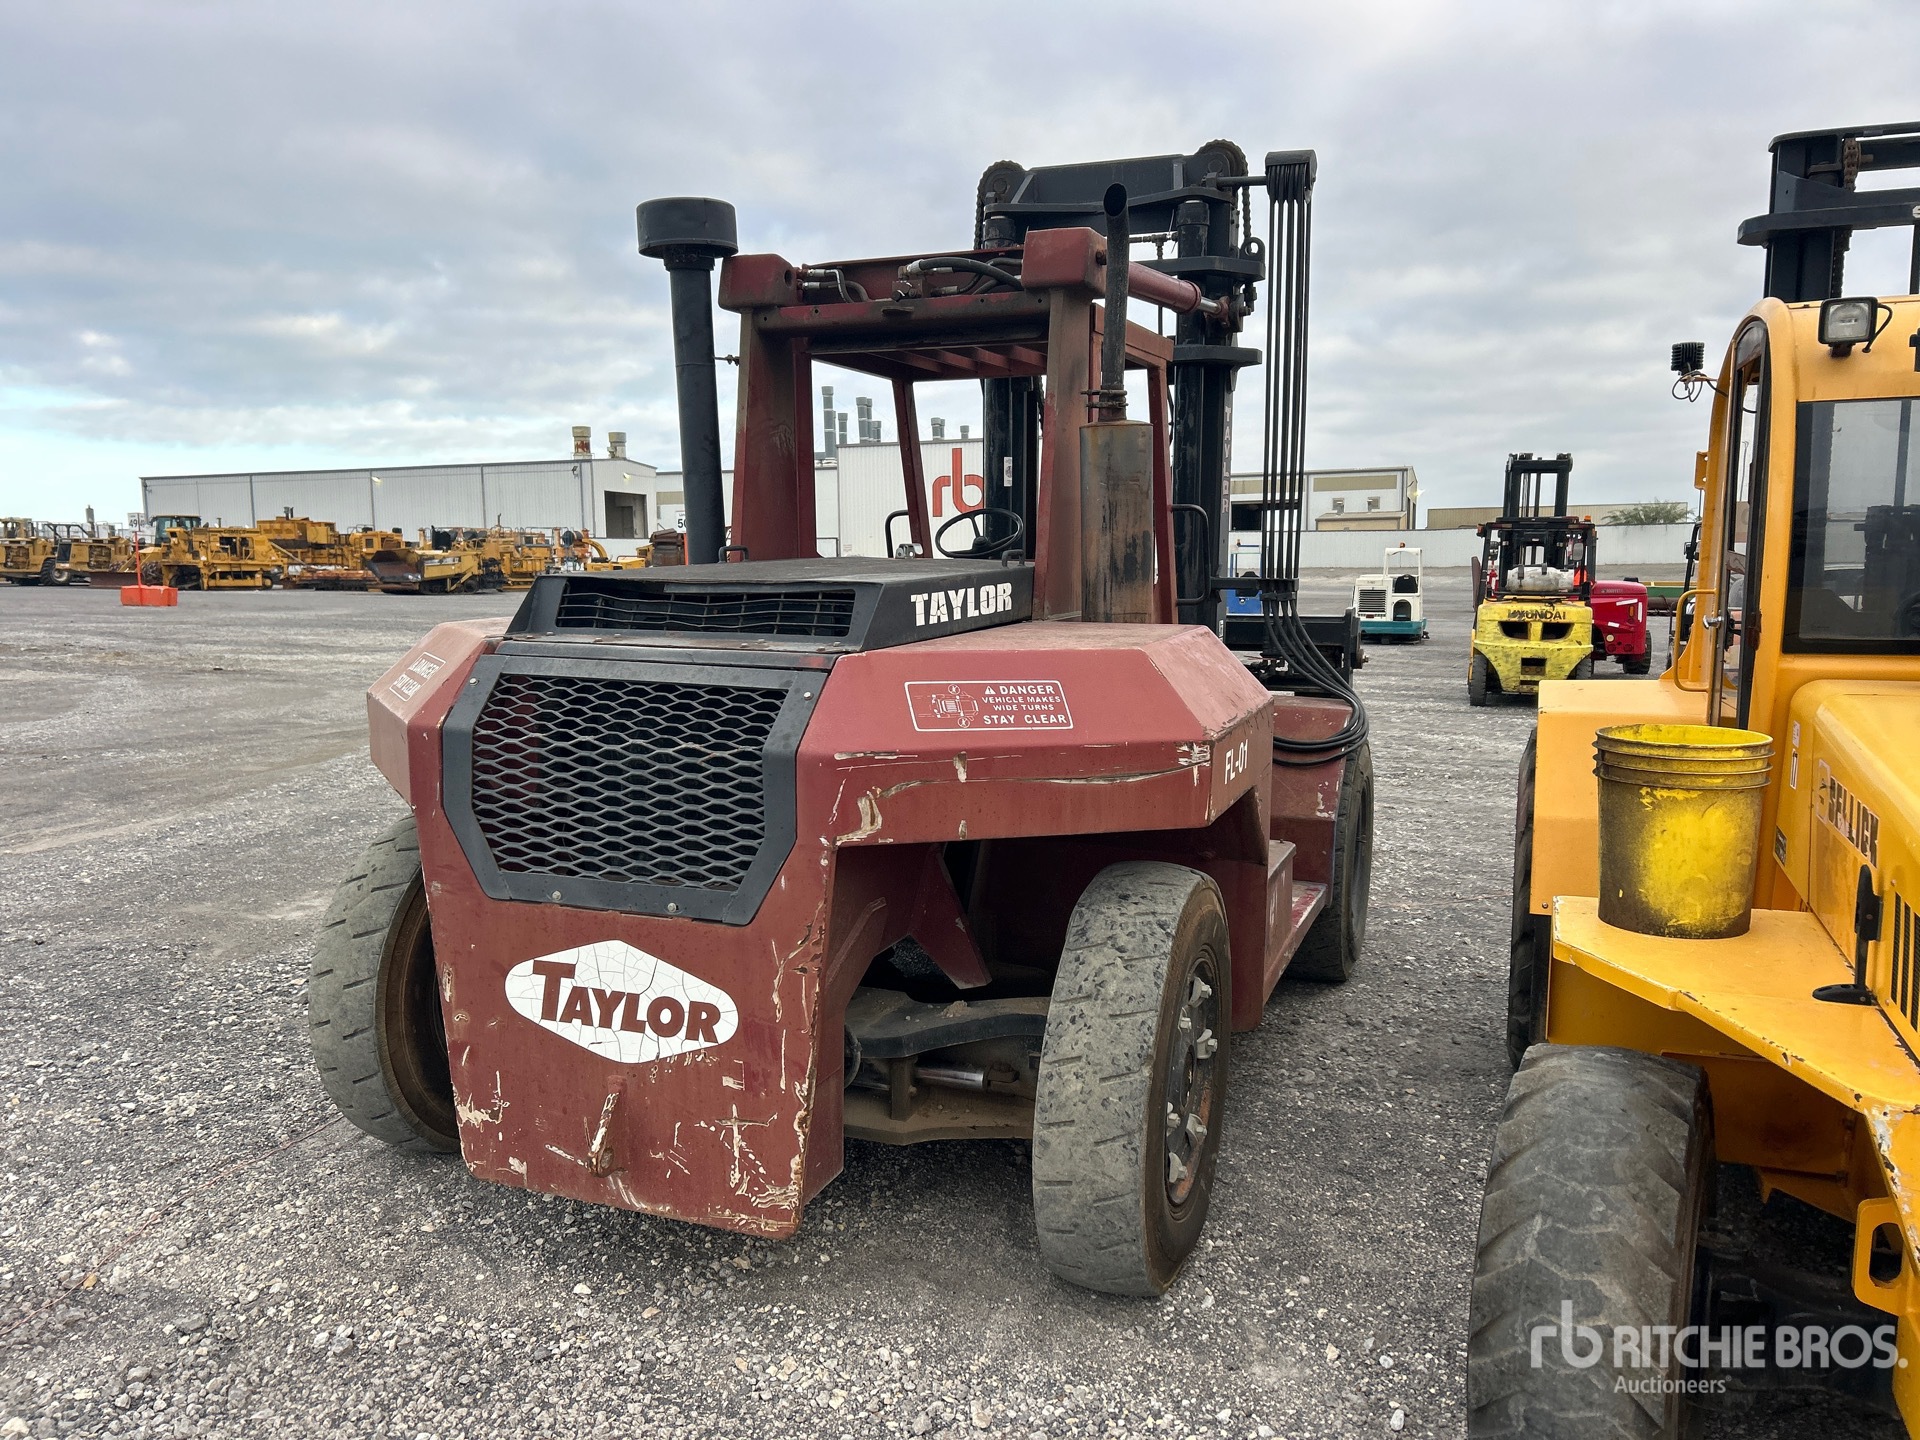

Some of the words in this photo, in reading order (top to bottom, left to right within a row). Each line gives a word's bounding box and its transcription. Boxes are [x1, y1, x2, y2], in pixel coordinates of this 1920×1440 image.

[1222, 405, 1231, 514] TAYLOR
[910, 582, 1012, 627] TAYLOR
[982, 696, 1023, 704] VEHICLE
[1027, 695, 1061, 703] MAKES
[999, 685, 1055, 695] DANGER
[983, 715, 1015, 725] STAY
[1024, 714, 1067, 724] CLEAR
[1224, 739, 1248, 785] FL-01
[532, 960, 719, 1044] TAYLOR
